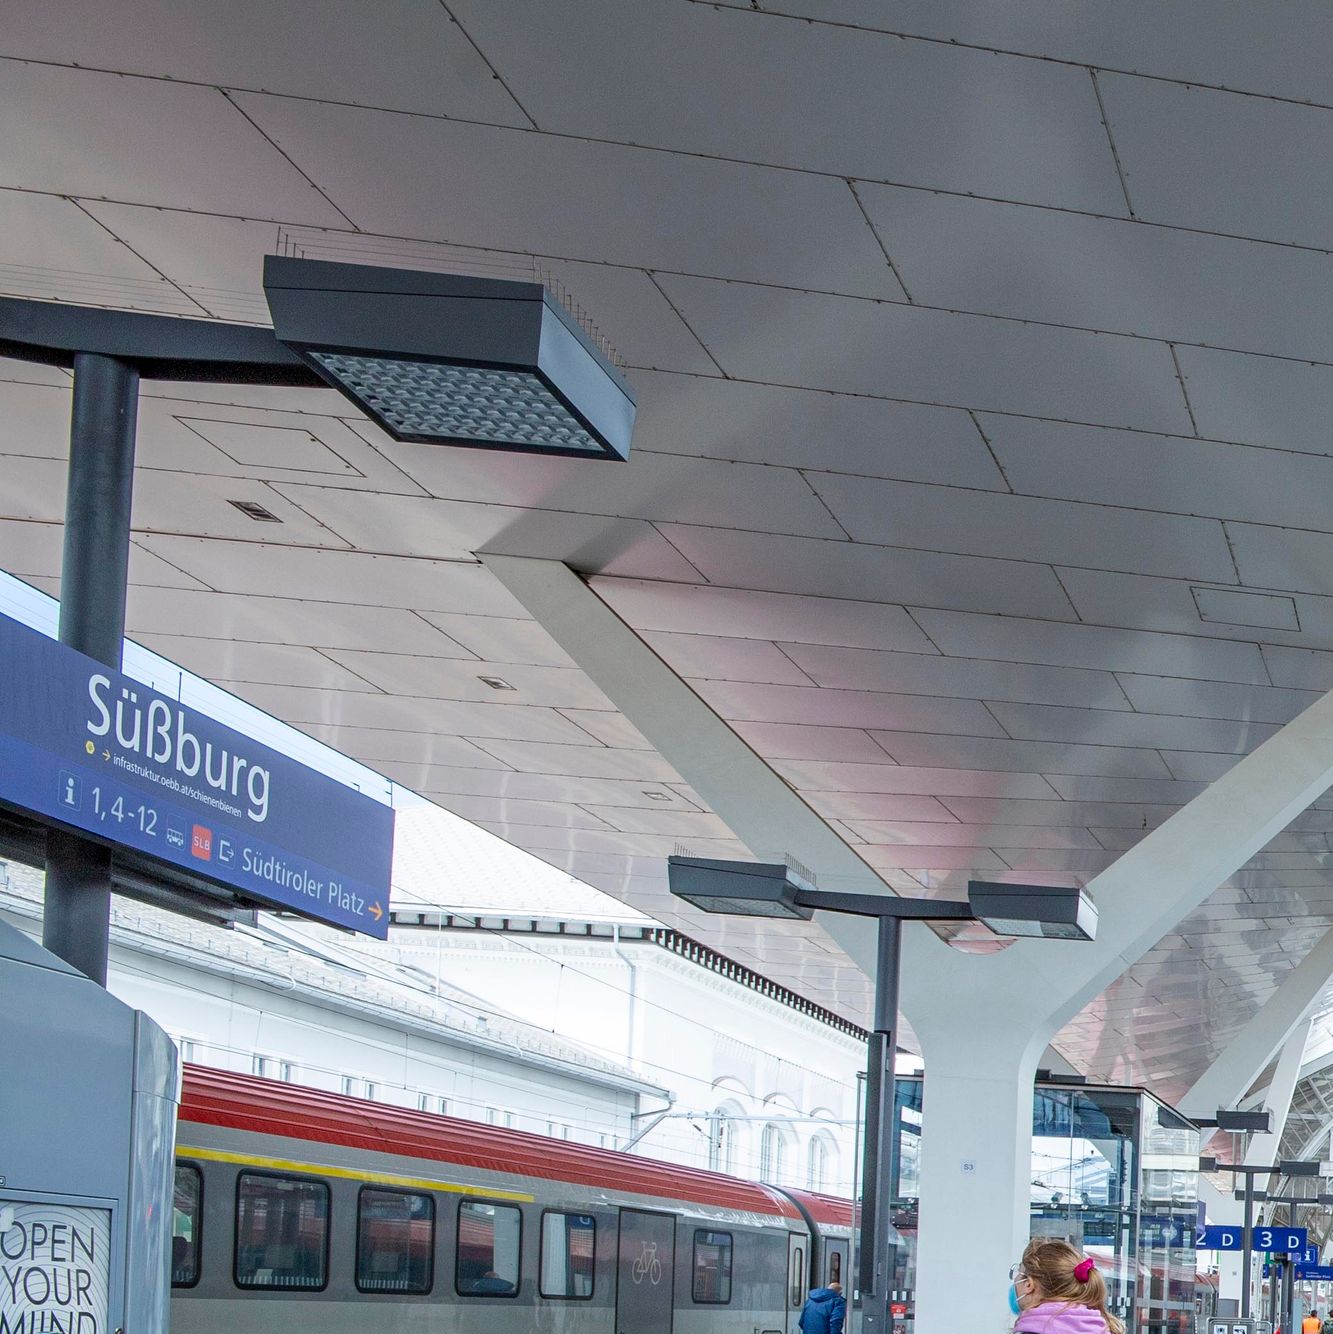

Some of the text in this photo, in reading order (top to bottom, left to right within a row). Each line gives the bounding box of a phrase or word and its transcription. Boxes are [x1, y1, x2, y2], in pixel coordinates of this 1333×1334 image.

[86, 673, 271, 823] Süßburg
[113, 755, 243, 819] infrastruktur.oebb.at/schienenbienen
[193, 834, 211, 851] SLB
[242, 848, 323, 899] Südtiroler
[328, 882, 365, 916] Platz
[1, 1220, 95, 1264] OPEN
[1222, 1233, 1234, 1247] D
[1260, 1231, 1300, 1249] 3 D
[1, 1265, 93, 1307] YOUR
